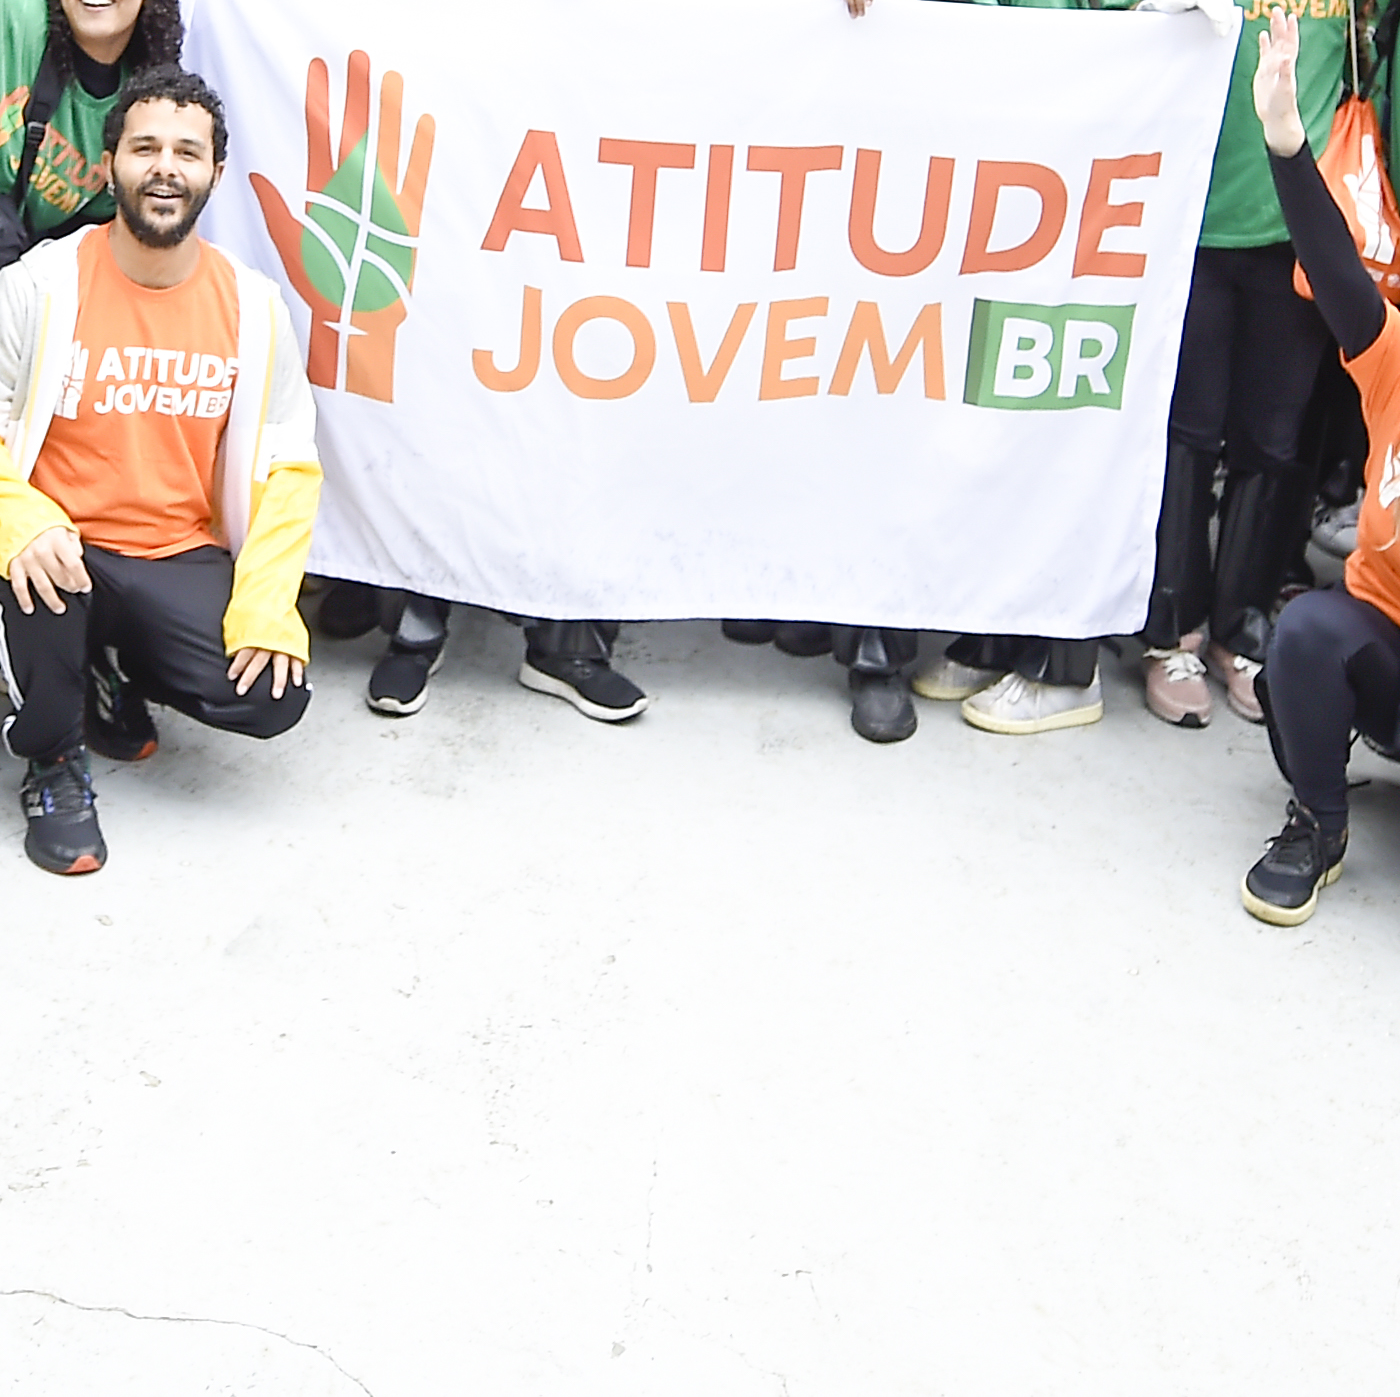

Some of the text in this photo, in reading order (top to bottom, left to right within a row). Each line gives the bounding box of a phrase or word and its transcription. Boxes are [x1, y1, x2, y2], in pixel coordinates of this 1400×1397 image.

[479, 129, 1162, 278] ATITUDE
[93, 384, 197, 417] JOVEM
[472, 285, 1119, 402] JOVEM BR
